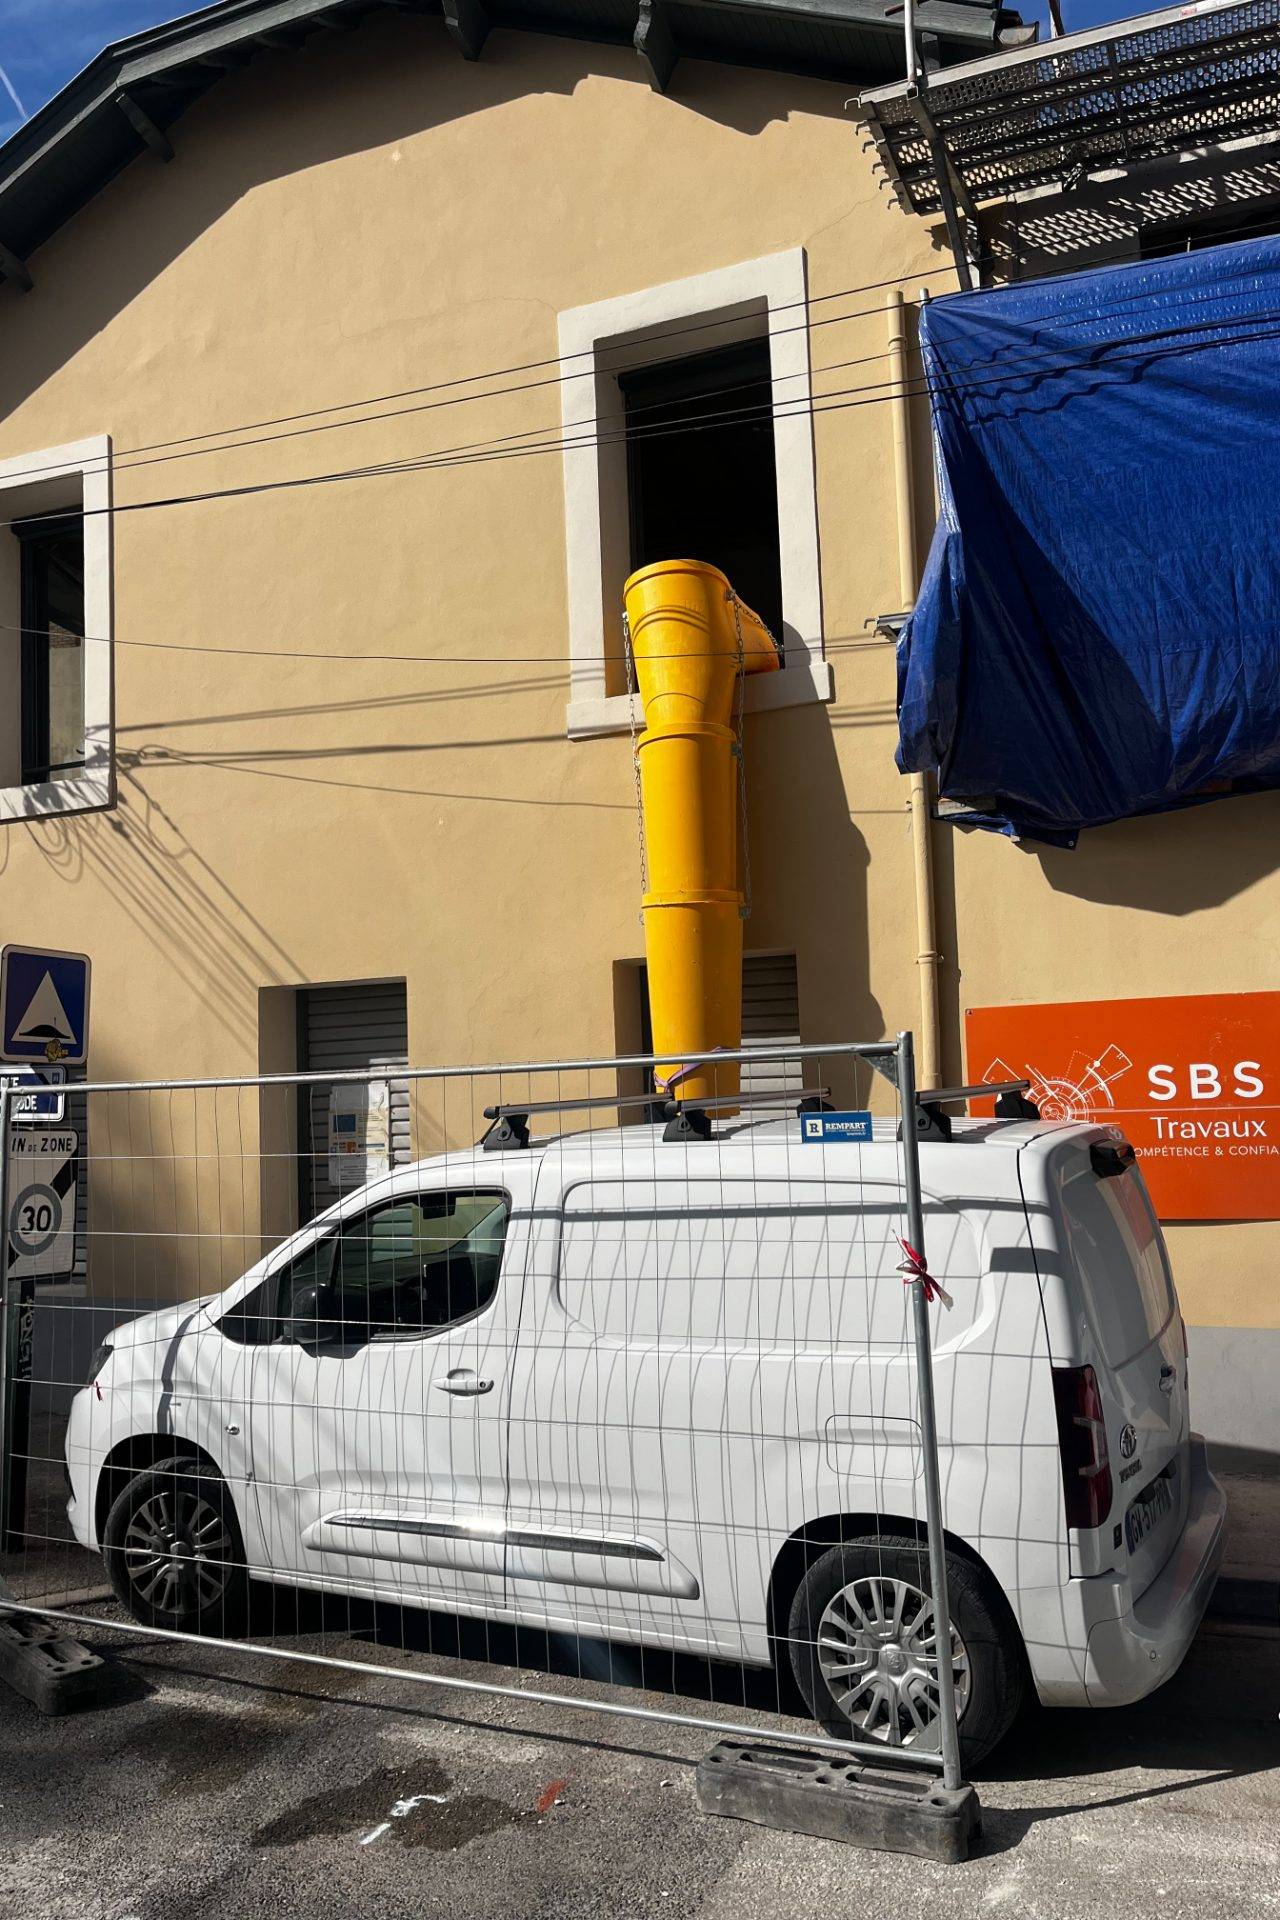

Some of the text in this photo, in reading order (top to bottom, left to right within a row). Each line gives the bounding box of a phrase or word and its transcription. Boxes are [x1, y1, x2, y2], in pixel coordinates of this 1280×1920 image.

[1148, 1061, 1264, 1100] SBS
[825, 1122, 866, 1130] REMPART
[1150, 1116, 1267, 1139] Travaux
[11, 1138, 26, 1152] IN
[41, 1138, 72, 1152] ZONE
[1133, 1144, 1209, 1157] OMPÉTENCE
[1215, 1147, 1223, 1156] &
[21, 1205, 51, 1234] 30
